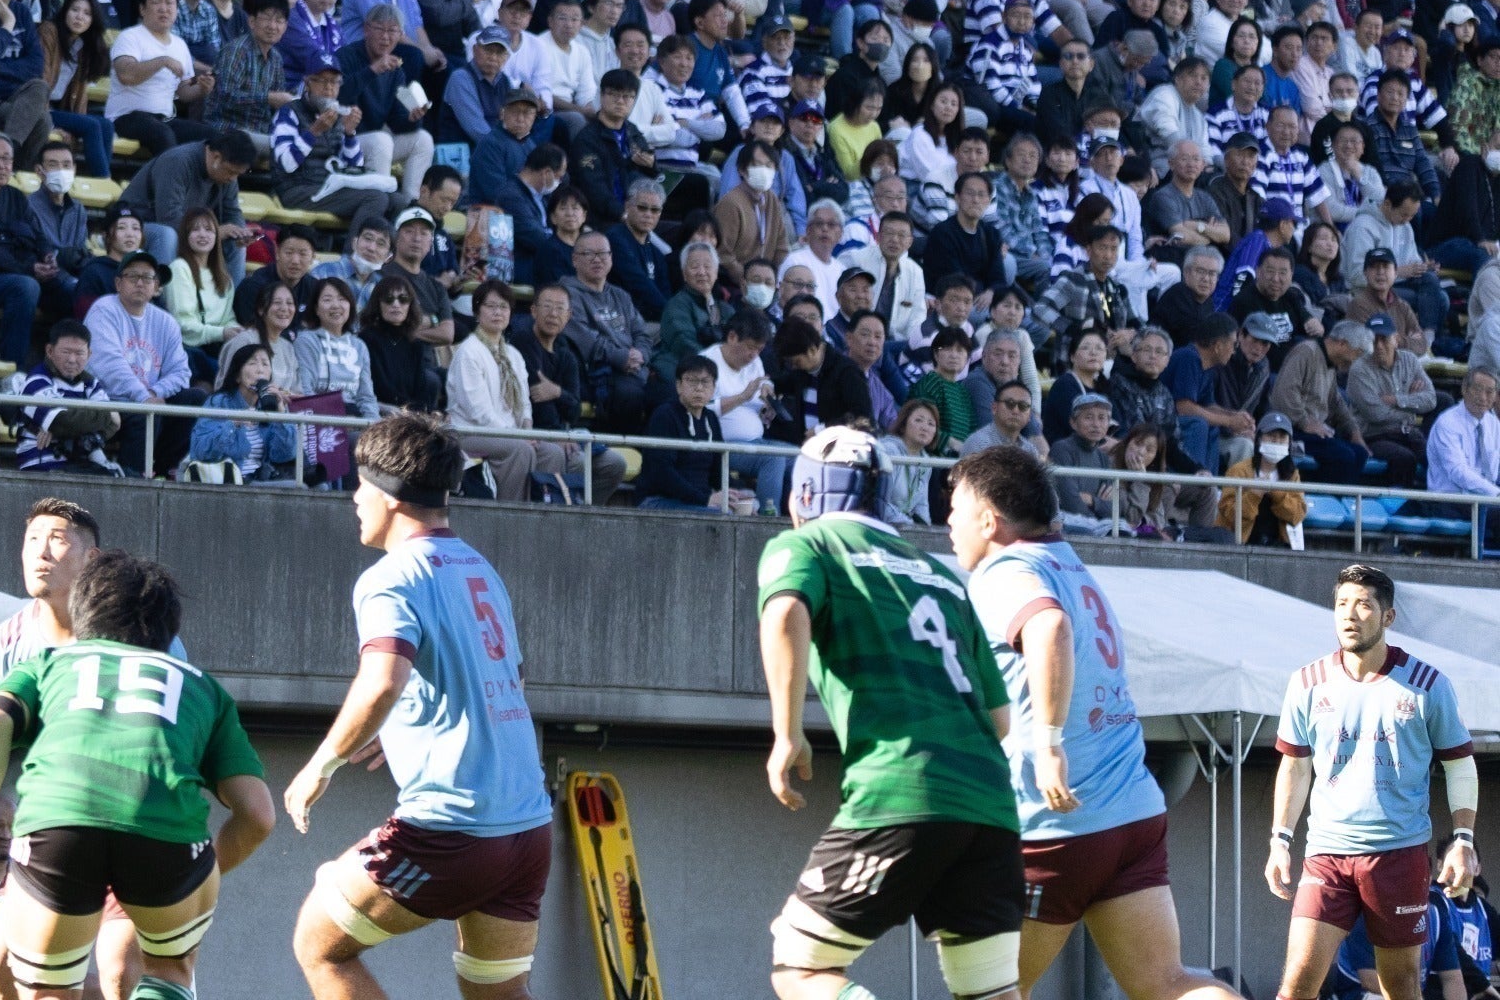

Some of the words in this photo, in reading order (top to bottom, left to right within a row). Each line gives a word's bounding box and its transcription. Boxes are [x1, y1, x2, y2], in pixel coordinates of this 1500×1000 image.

[465, 577, 506, 662] 5
[1080, 585, 1119, 670] 3
[68, 654, 184, 725] 19
